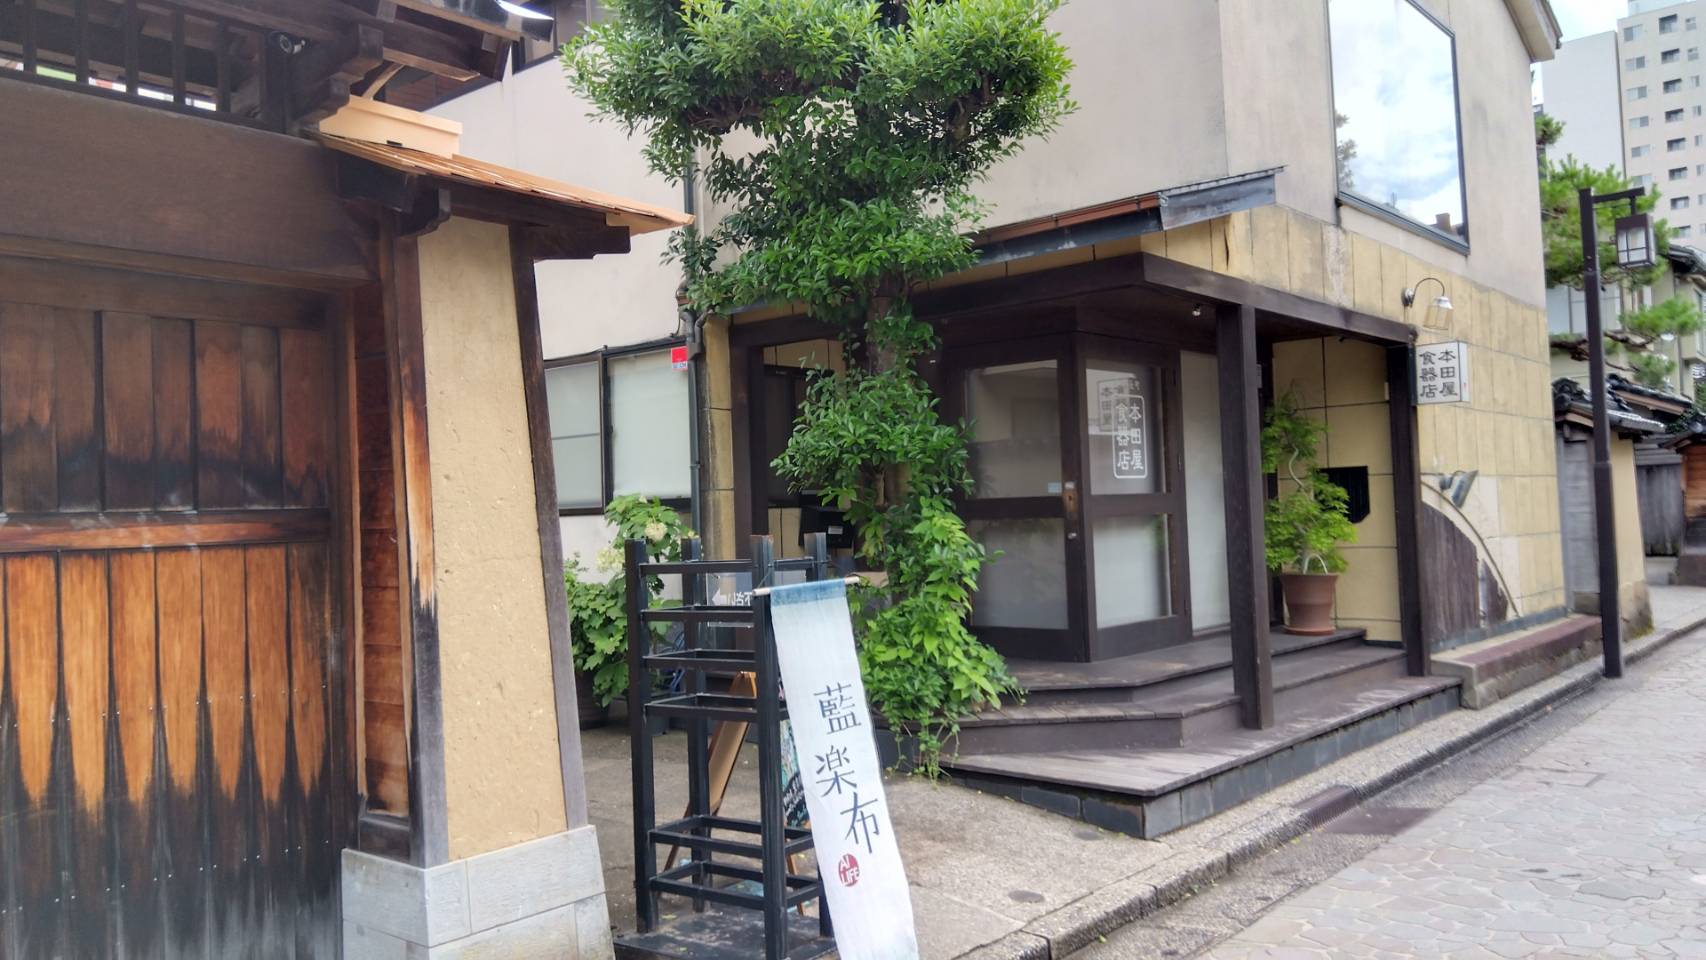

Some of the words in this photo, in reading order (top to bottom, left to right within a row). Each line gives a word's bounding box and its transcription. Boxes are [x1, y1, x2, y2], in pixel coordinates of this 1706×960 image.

[1419, 351, 1438, 398] 食器店
[1438, 349, 1459, 397] 本田屋
[1115, 402, 1130, 470] 食器店
[1129, 402, 1144, 470] 本田屋
[813, 682, 880, 854] 藍楽布
[839, 854, 851, 872] AI
[840, 866, 861, 886] LIFE
